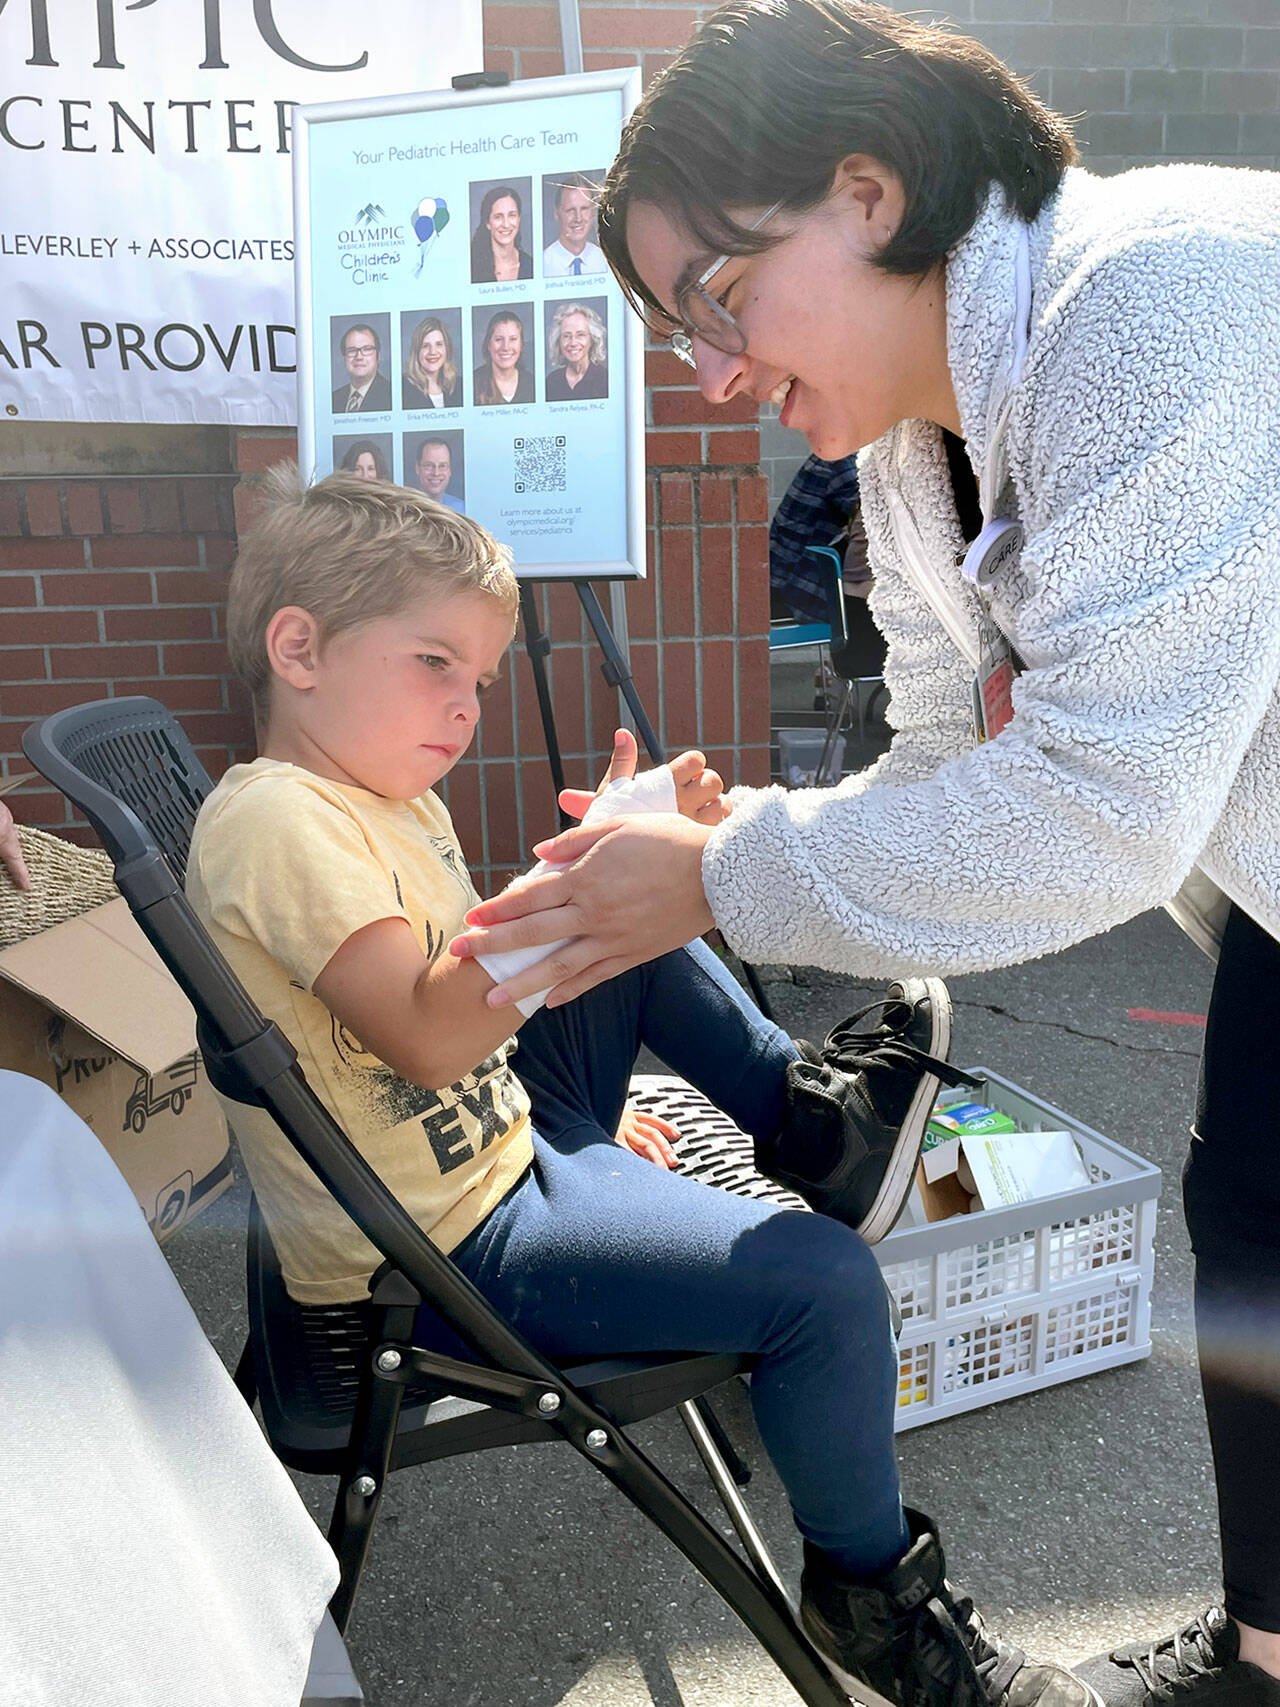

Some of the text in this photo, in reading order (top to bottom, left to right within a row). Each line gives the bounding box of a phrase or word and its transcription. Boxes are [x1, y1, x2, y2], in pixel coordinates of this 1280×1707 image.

[352, 130, 578, 165] Your Pediatric Health Care Team
[338, 226, 404, 243] OLYMPIC
[128, 240, 142, 256] +
[148, 238, 295, 261] ASSOCIATES
[340, 251, 401, 269] Children's
[352, 268, 389, 285] Clinic
[500, 507, 521, 516] Learn
[522, 508, 542, 516] more
[543, 507, 564, 515] about
[989, 534, 1018, 575] CARE
